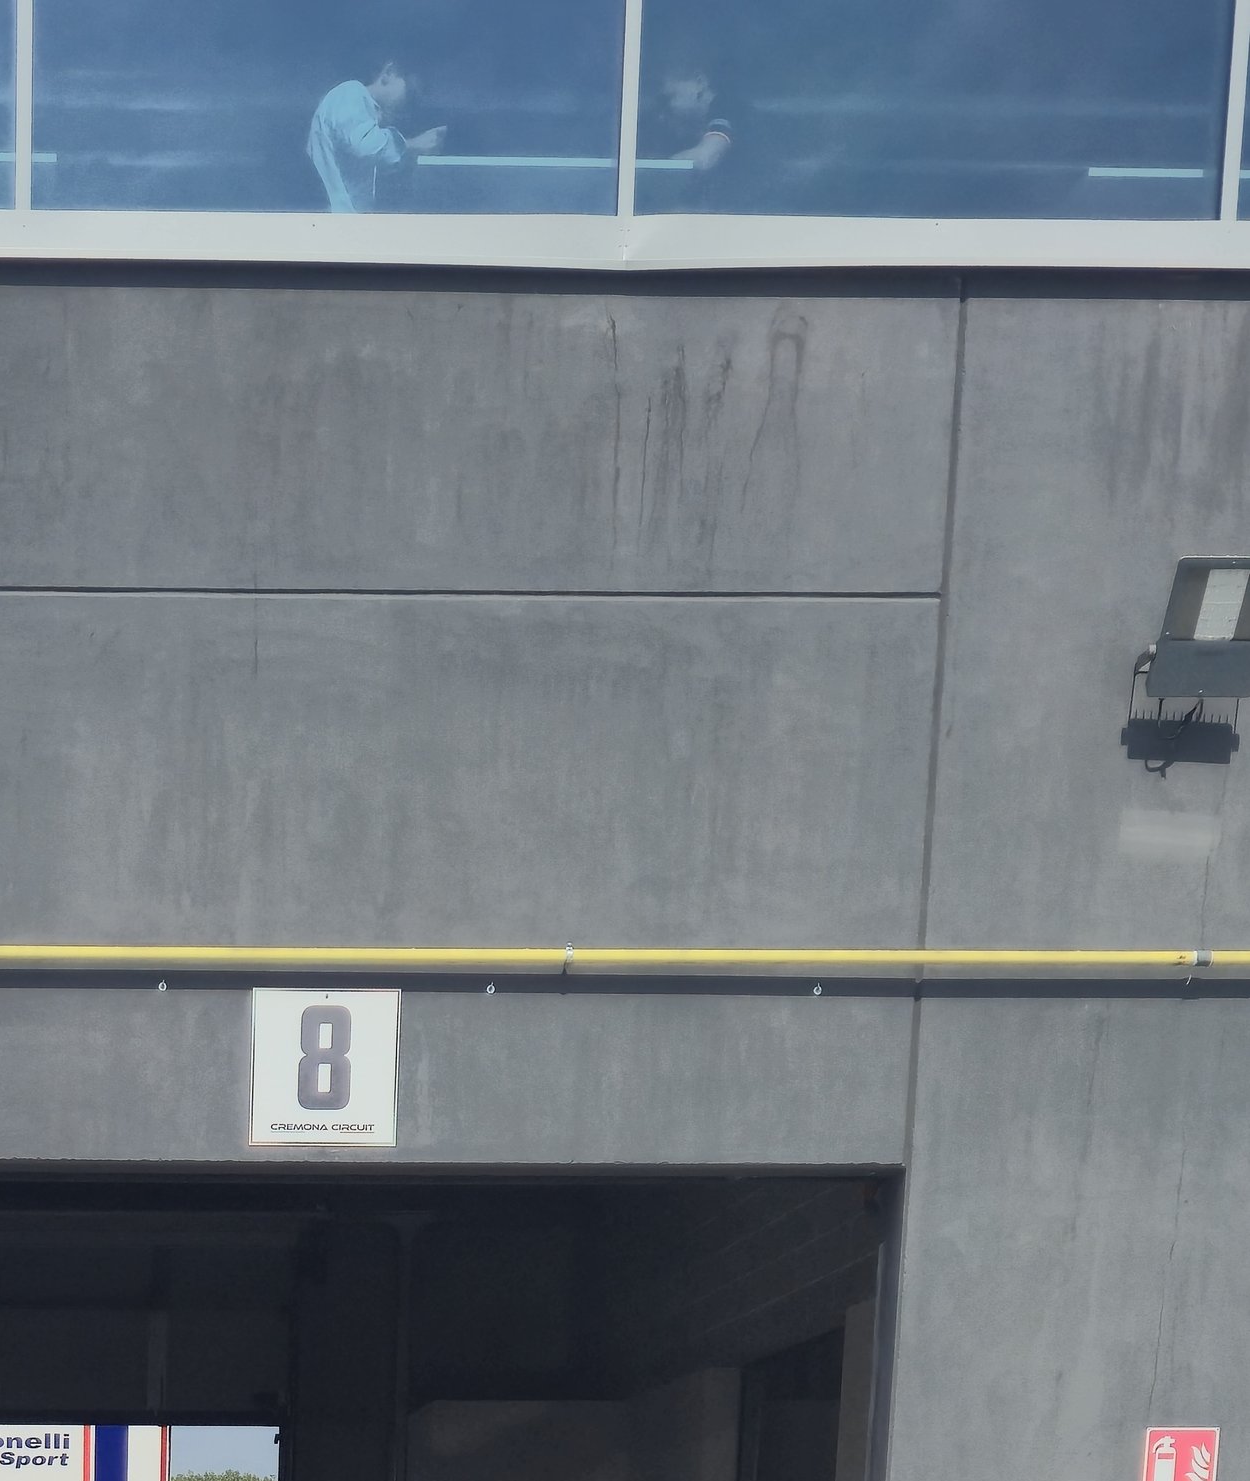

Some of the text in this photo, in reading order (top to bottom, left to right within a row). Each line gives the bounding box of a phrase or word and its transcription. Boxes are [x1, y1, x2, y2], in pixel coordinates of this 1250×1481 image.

[298, 1005, 351, 1110] 8
[270, 1123, 375, 1131] CREMONA CIRCUIT
